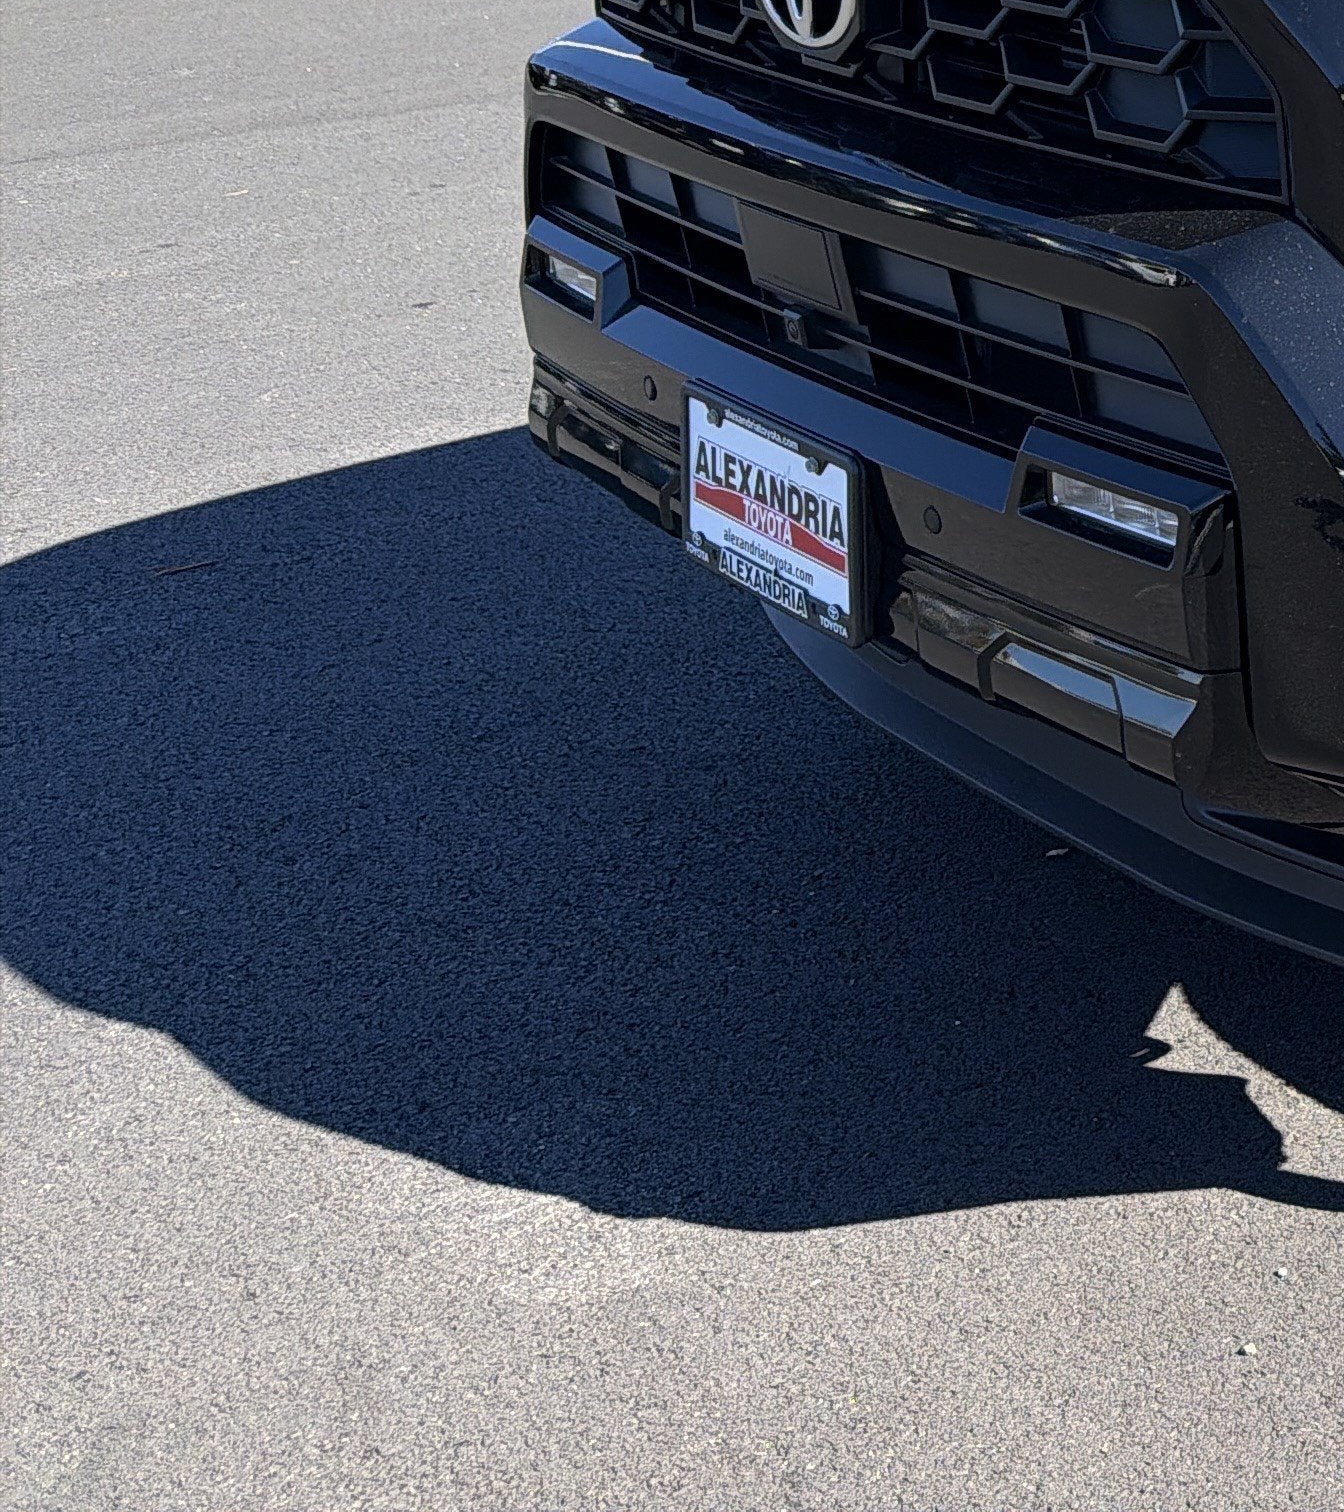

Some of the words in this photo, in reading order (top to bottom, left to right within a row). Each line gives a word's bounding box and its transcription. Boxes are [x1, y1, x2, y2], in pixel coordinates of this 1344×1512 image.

[694, 439, 847, 549] ALEXANDRIA
[743, 500, 794, 546] TOYOTA
[719, 547, 809, 619] ALEXANDRIA
[723, 528, 814, 587] alexandriatoyota.com
[819, 615, 849, 638] TOYOTA
